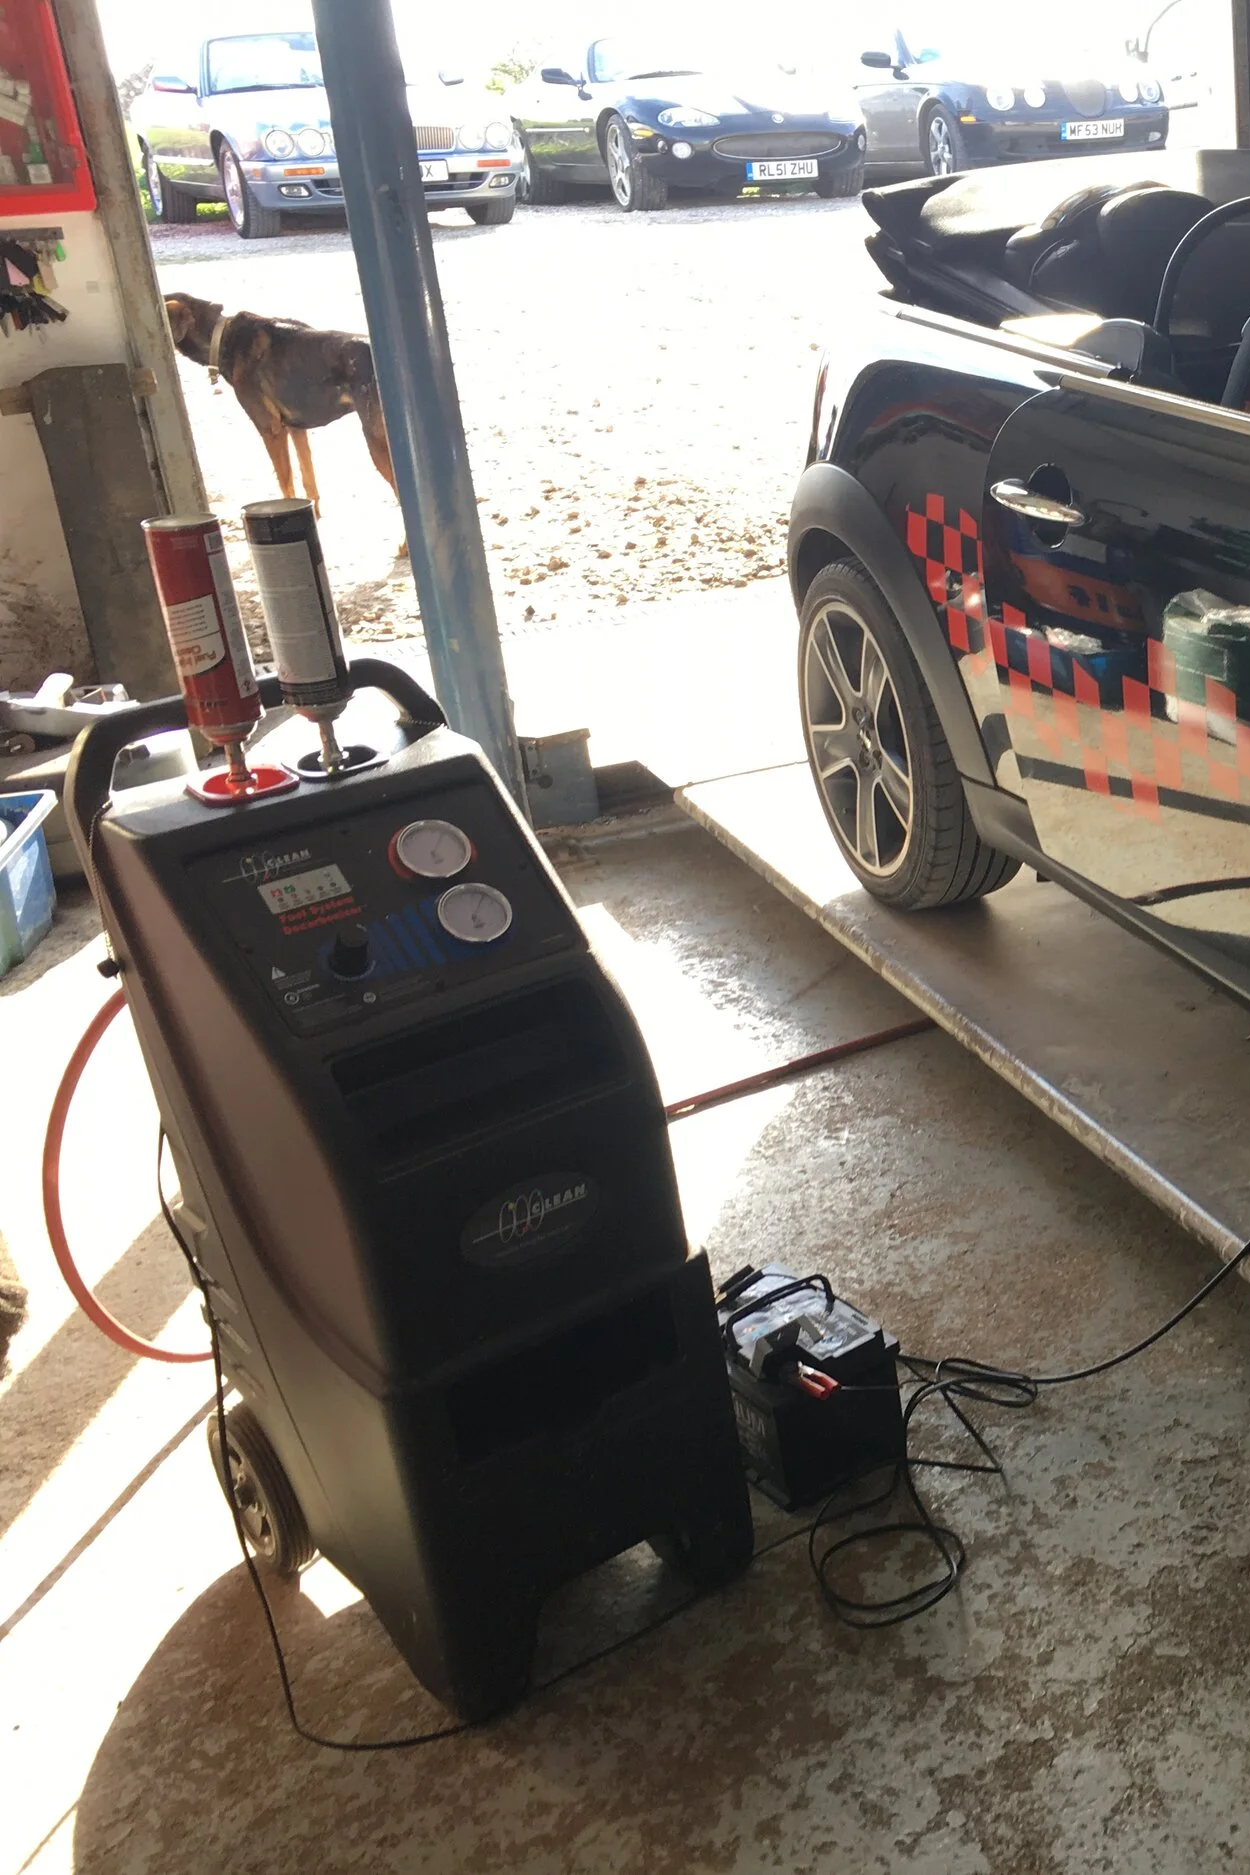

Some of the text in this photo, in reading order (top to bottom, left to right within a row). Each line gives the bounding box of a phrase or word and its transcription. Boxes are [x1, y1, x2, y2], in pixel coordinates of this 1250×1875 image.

[1069, 122, 1122, 137] MF53 NUH
[759, 162, 814, 177] RL51 ZHU
[531, 1182, 587, 1214] CLEAN
